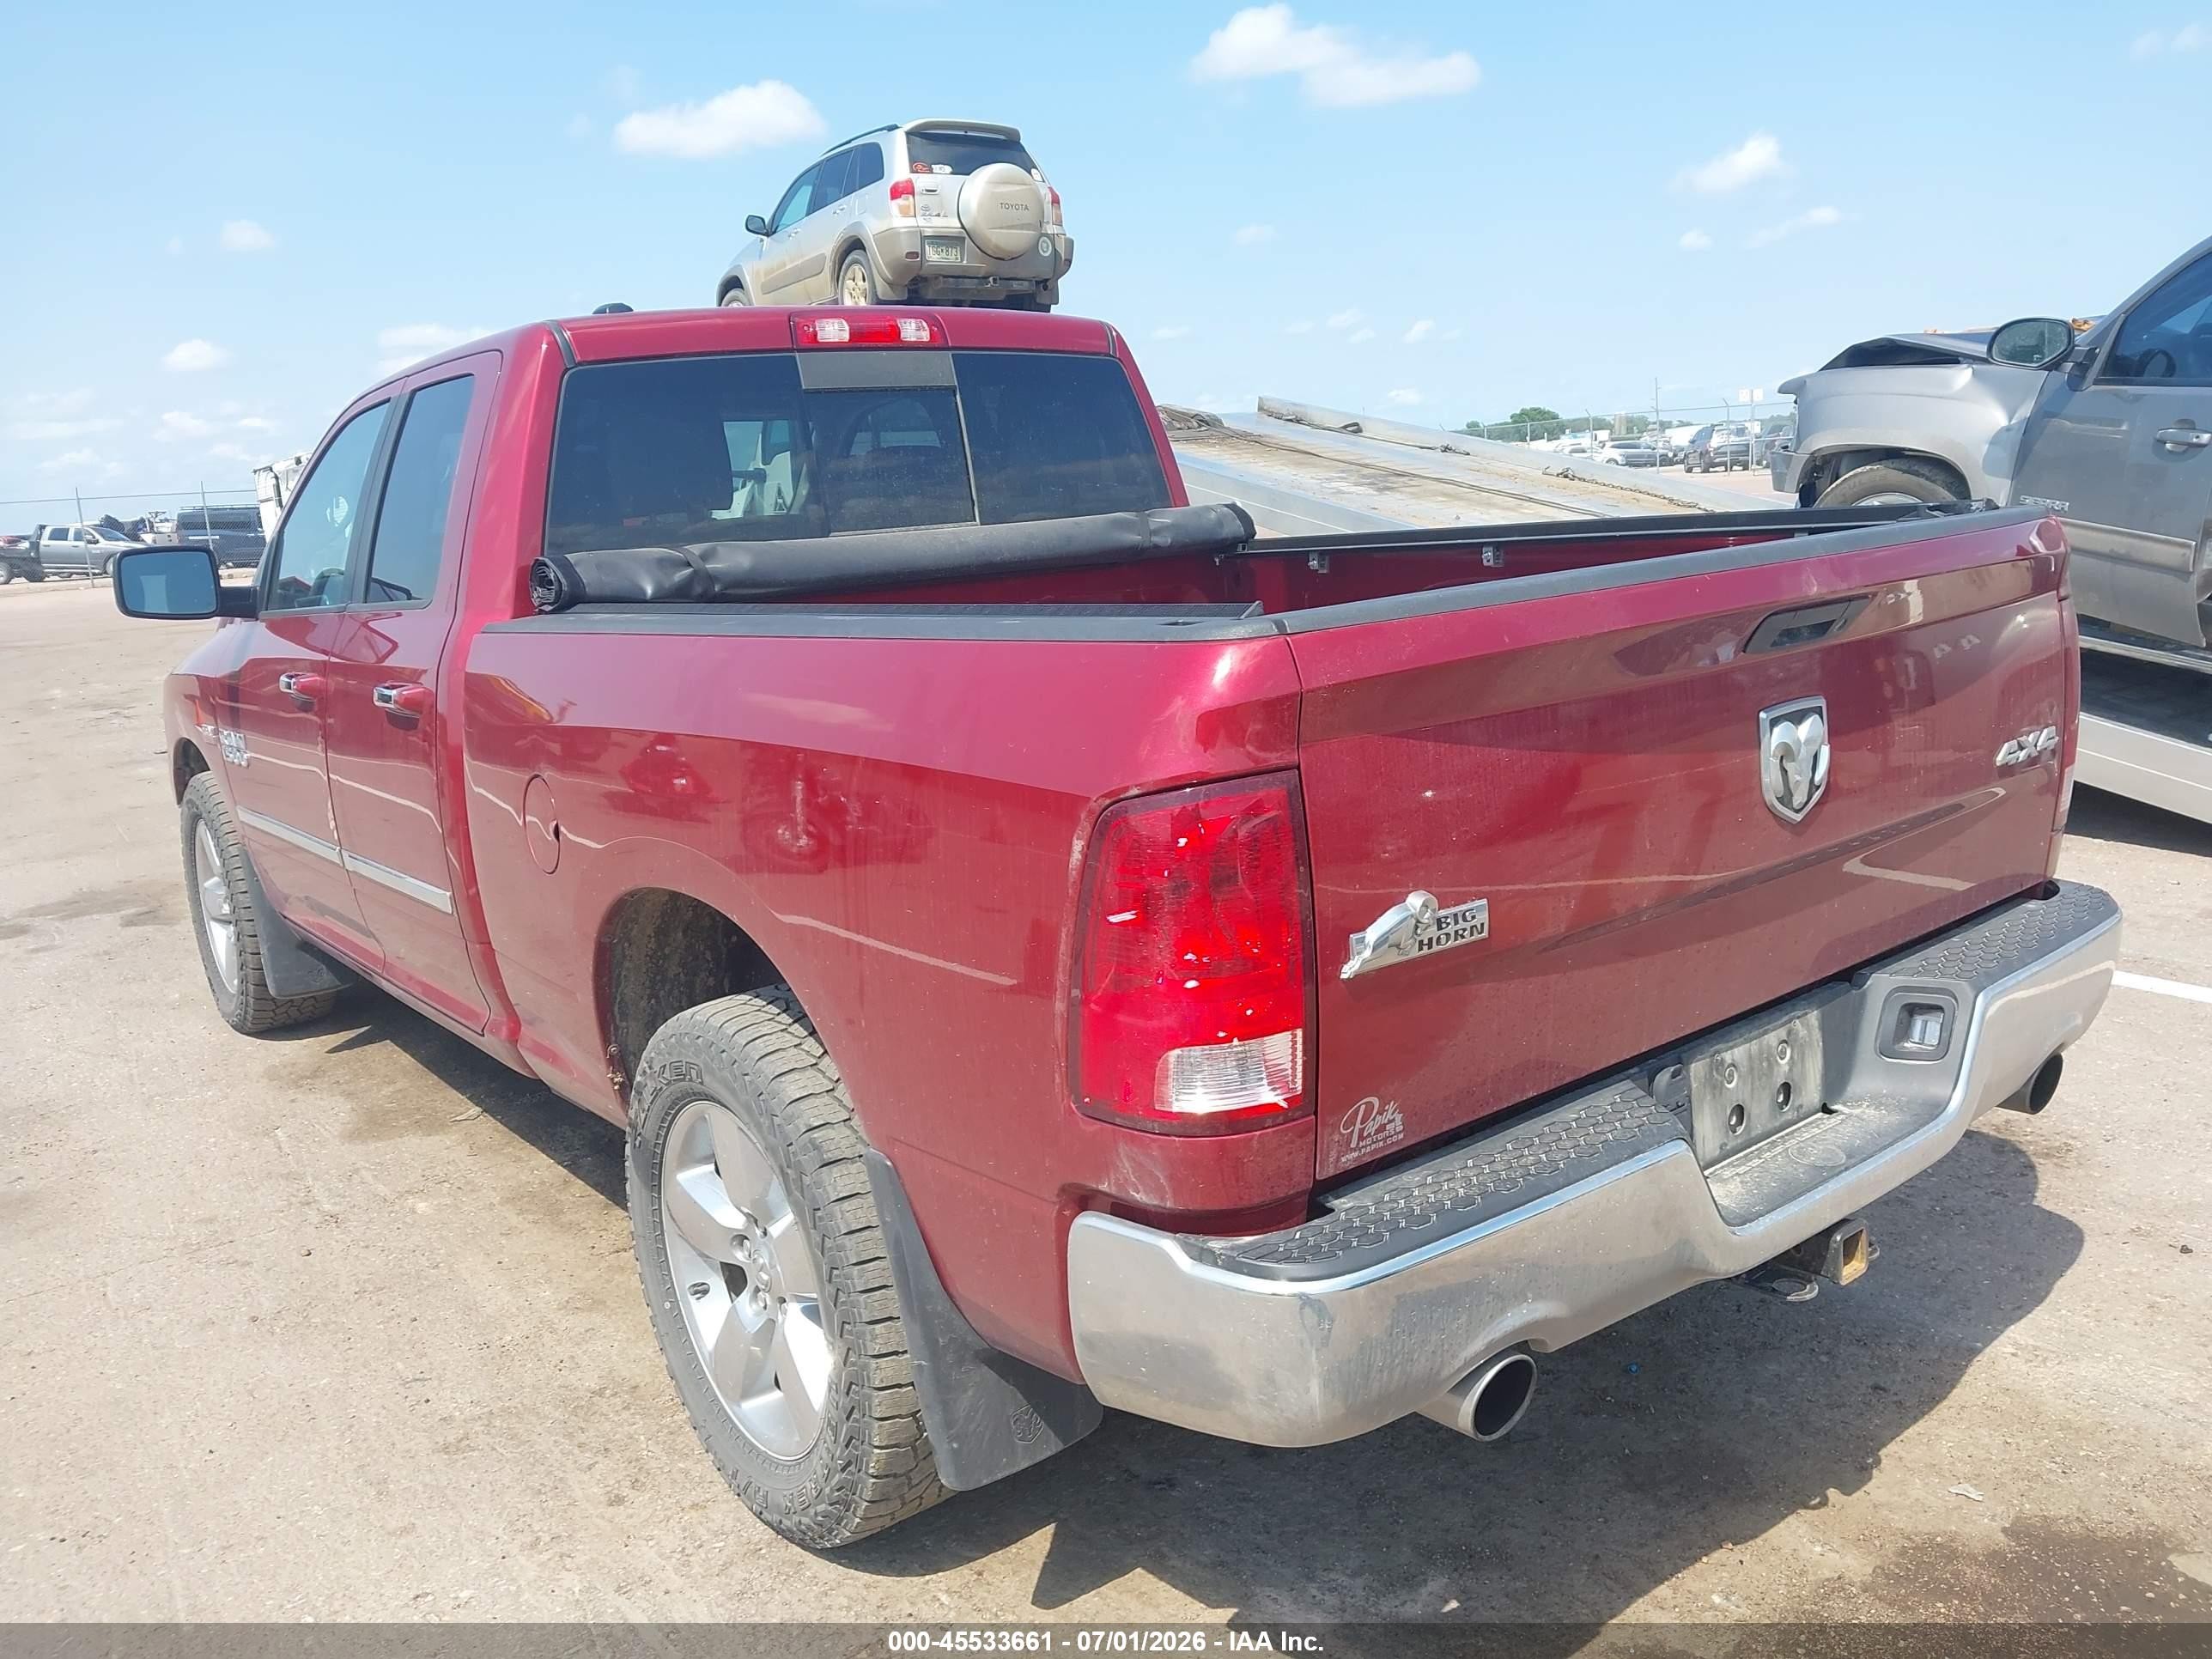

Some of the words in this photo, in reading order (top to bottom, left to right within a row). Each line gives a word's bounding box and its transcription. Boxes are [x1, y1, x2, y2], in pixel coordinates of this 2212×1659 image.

[999, 202, 1030, 211] TOYOTA
[1436, 908, 1477, 932] BIG
[1417, 922, 1486, 953] HORN
[1359, 1129, 1395, 1148] MOTORS
